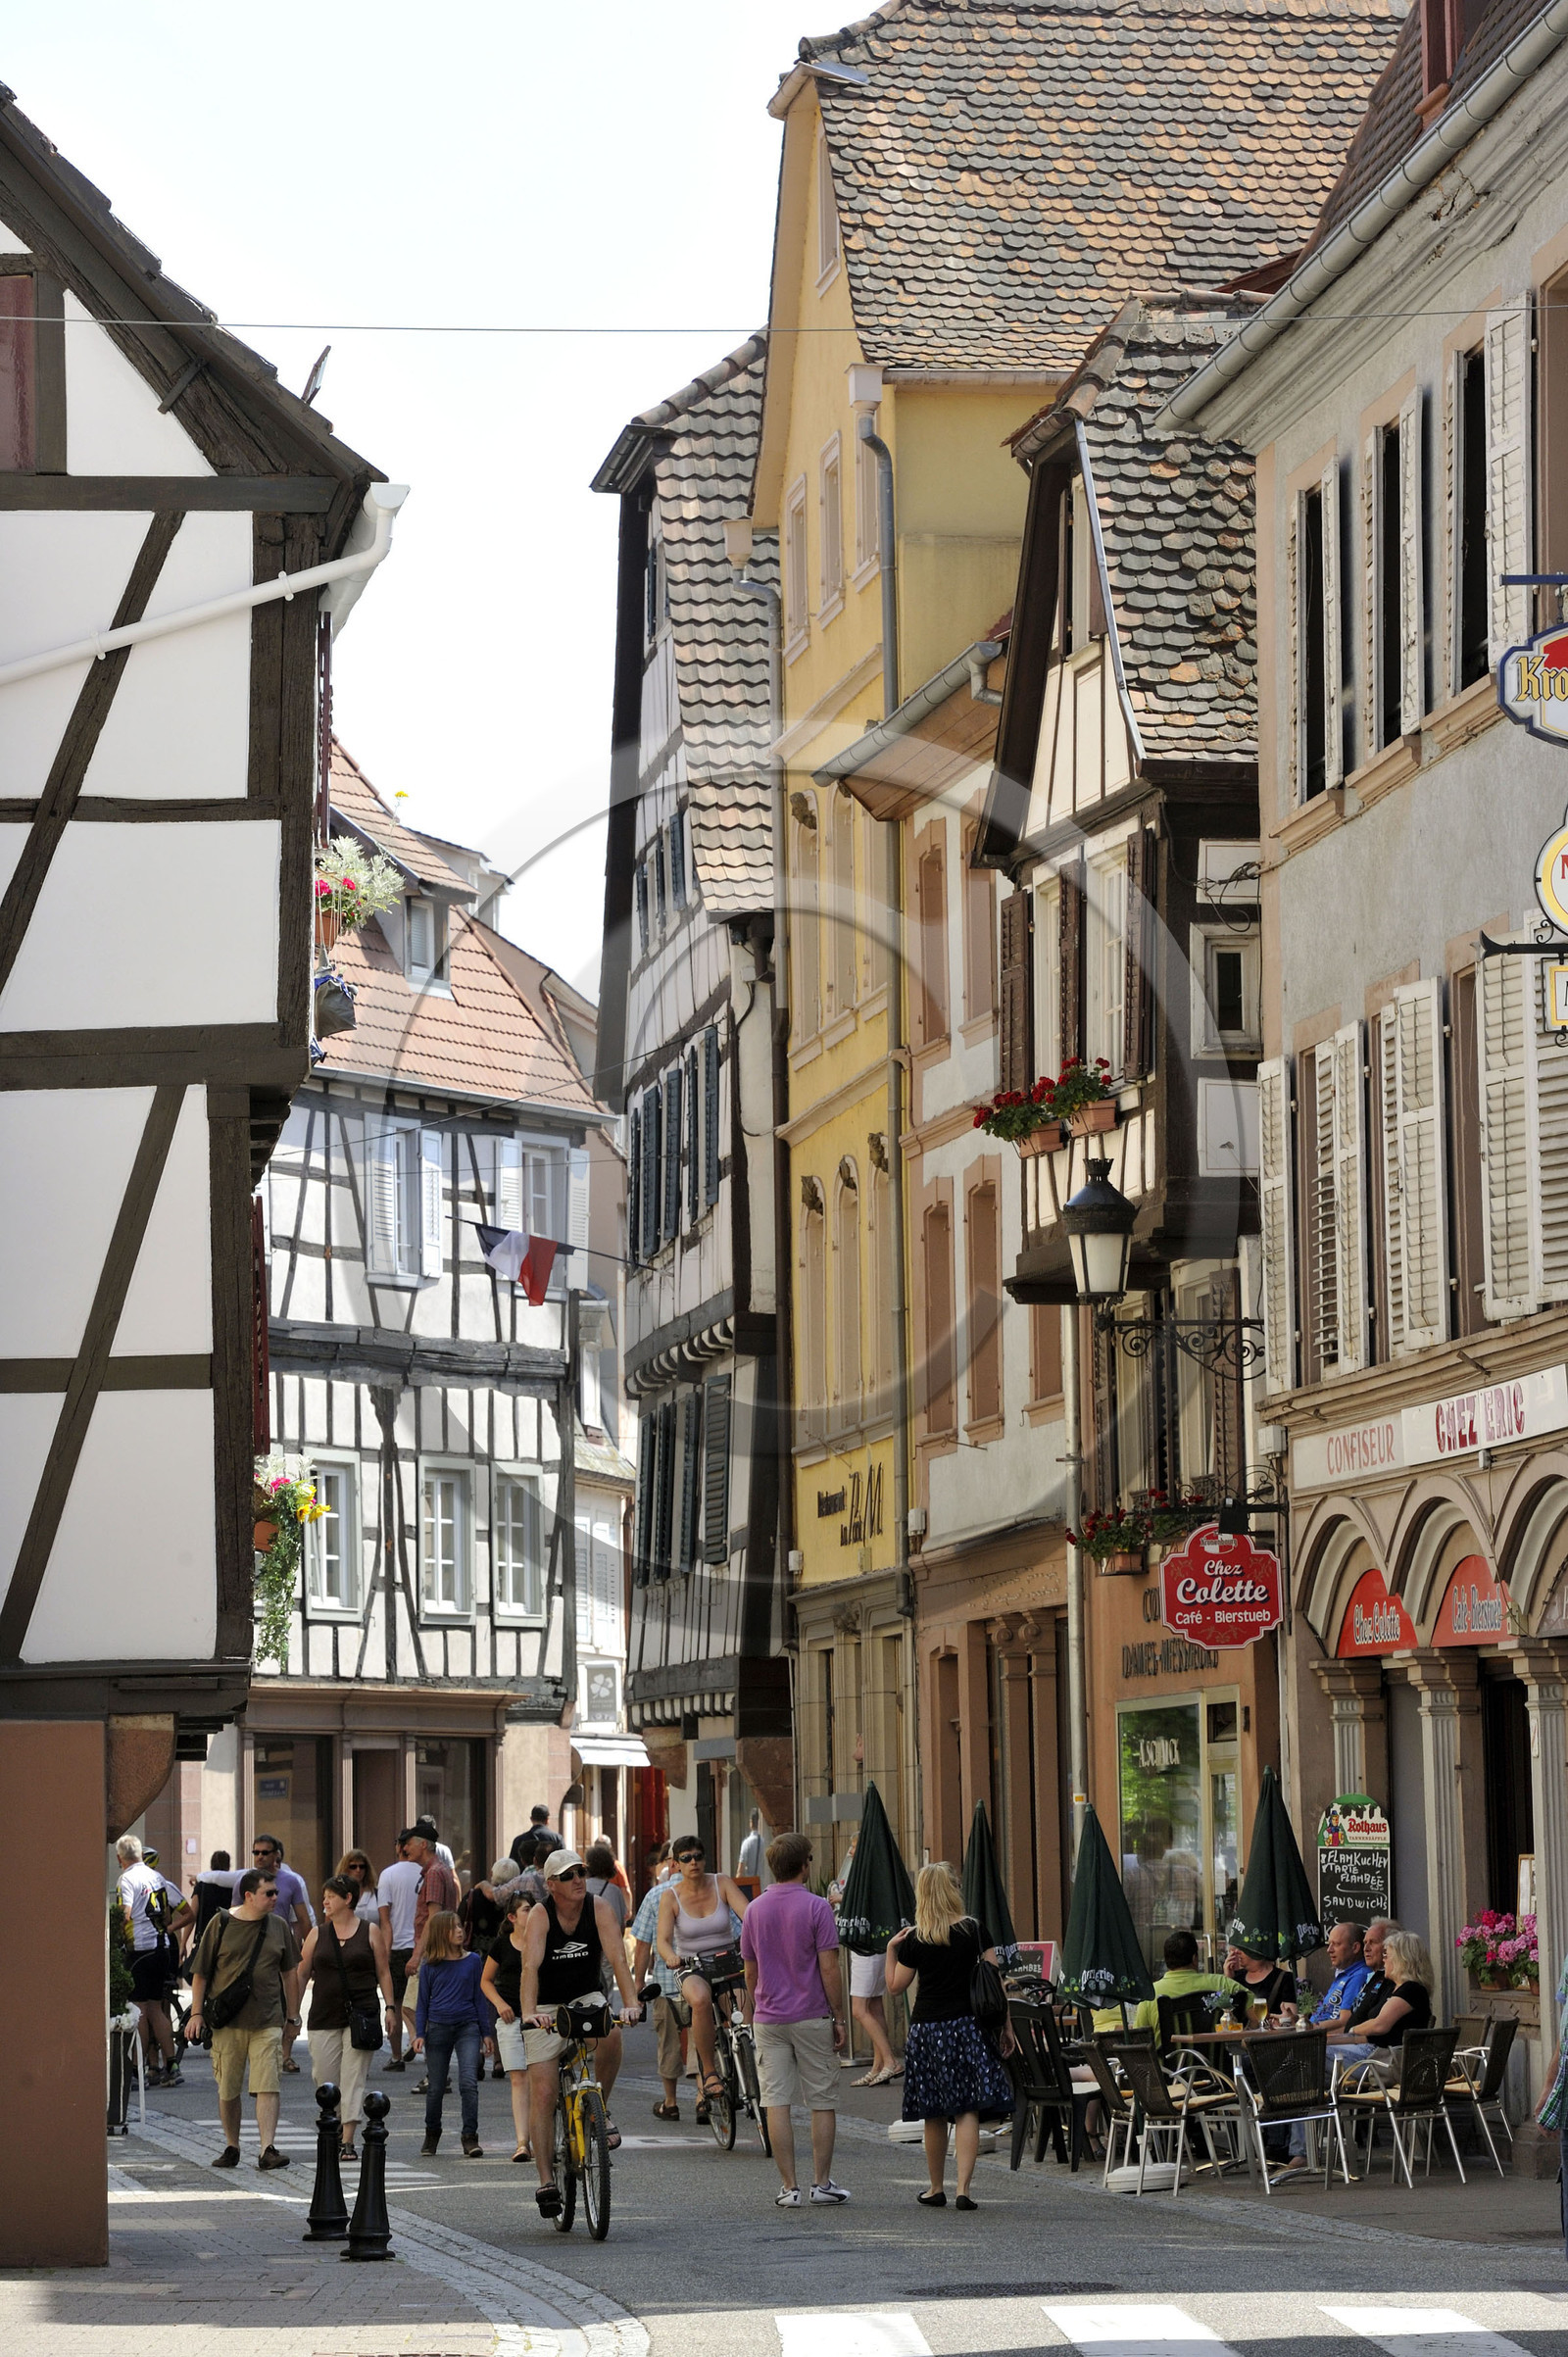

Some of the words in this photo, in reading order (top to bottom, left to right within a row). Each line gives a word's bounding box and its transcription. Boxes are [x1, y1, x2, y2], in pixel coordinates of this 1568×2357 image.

[1436, 1396, 1478, 1453] CHEZ
[1484, 1382, 1525, 1442] ERIC
[1327, 1423, 1396, 1475] CONFISEUR
[1203, 1559, 1244, 1576] Chez
[1176, 1577, 1270, 1605] Colette
[1175, 1609, 1203, 1625] Café
[1214, 1608, 1271, 1624] Bierstueb
[1353, 1603, 1373, 1645] Chez
[1373, 1600, 1400, 1644] Colette
[1348, 1818, 1388, 1836] Rothaus
